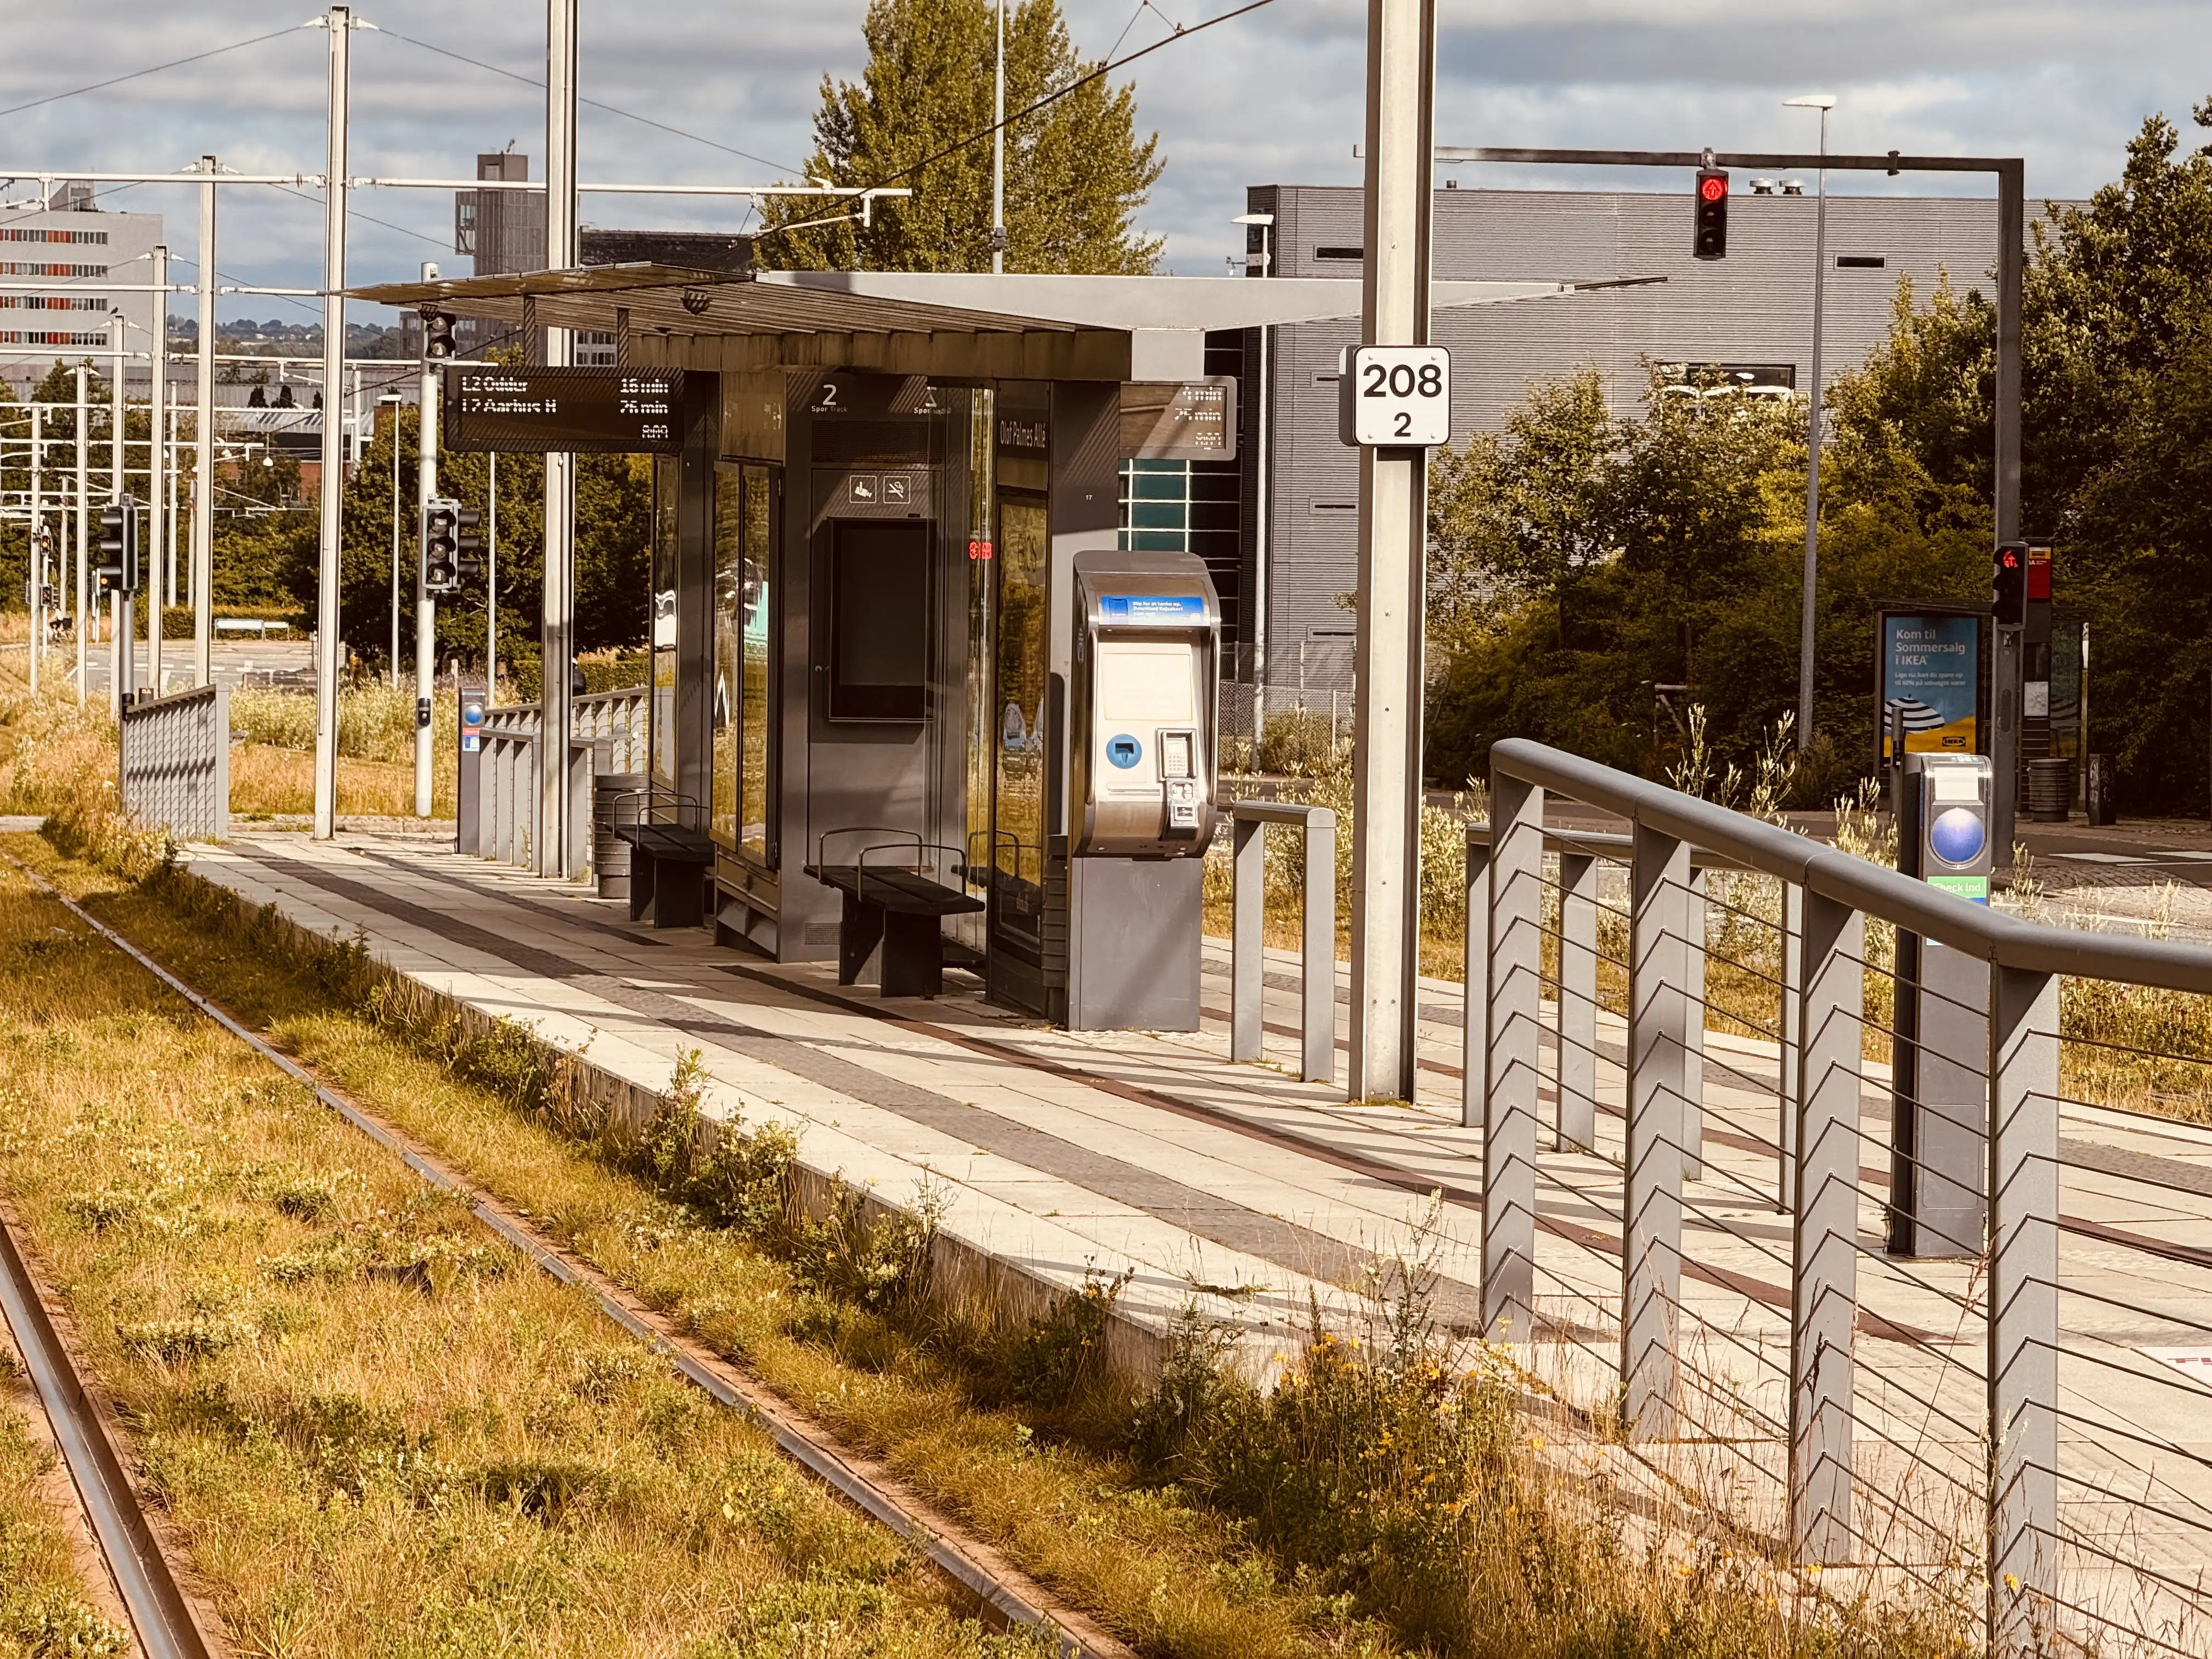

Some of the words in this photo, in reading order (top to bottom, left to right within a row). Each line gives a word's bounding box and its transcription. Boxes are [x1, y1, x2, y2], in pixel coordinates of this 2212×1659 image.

[641, 379, 668, 393] min
[1363, 364, 1442, 398] 208
[823, 384, 837, 406] 2
[483, 399, 541, 413] Aarhus
[545, 399, 557, 413] H
[641, 400, 668, 414] min
[913, 407, 930, 415] Spor
[1393, 412, 1412, 437] 2
[1000, 419, 1012, 445] Olof
[1013, 421, 1033, 447] Palmes
[1034, 422, 1046, 448] Allé
[1896, 629, 1922, 639] Kom
[1925, 629, 1936, 639] til
[1895, 642, 1966, 655] Sommersalg
[1895, 654, 1899, 665] i
[1965, 882, 1982, 892] ind
